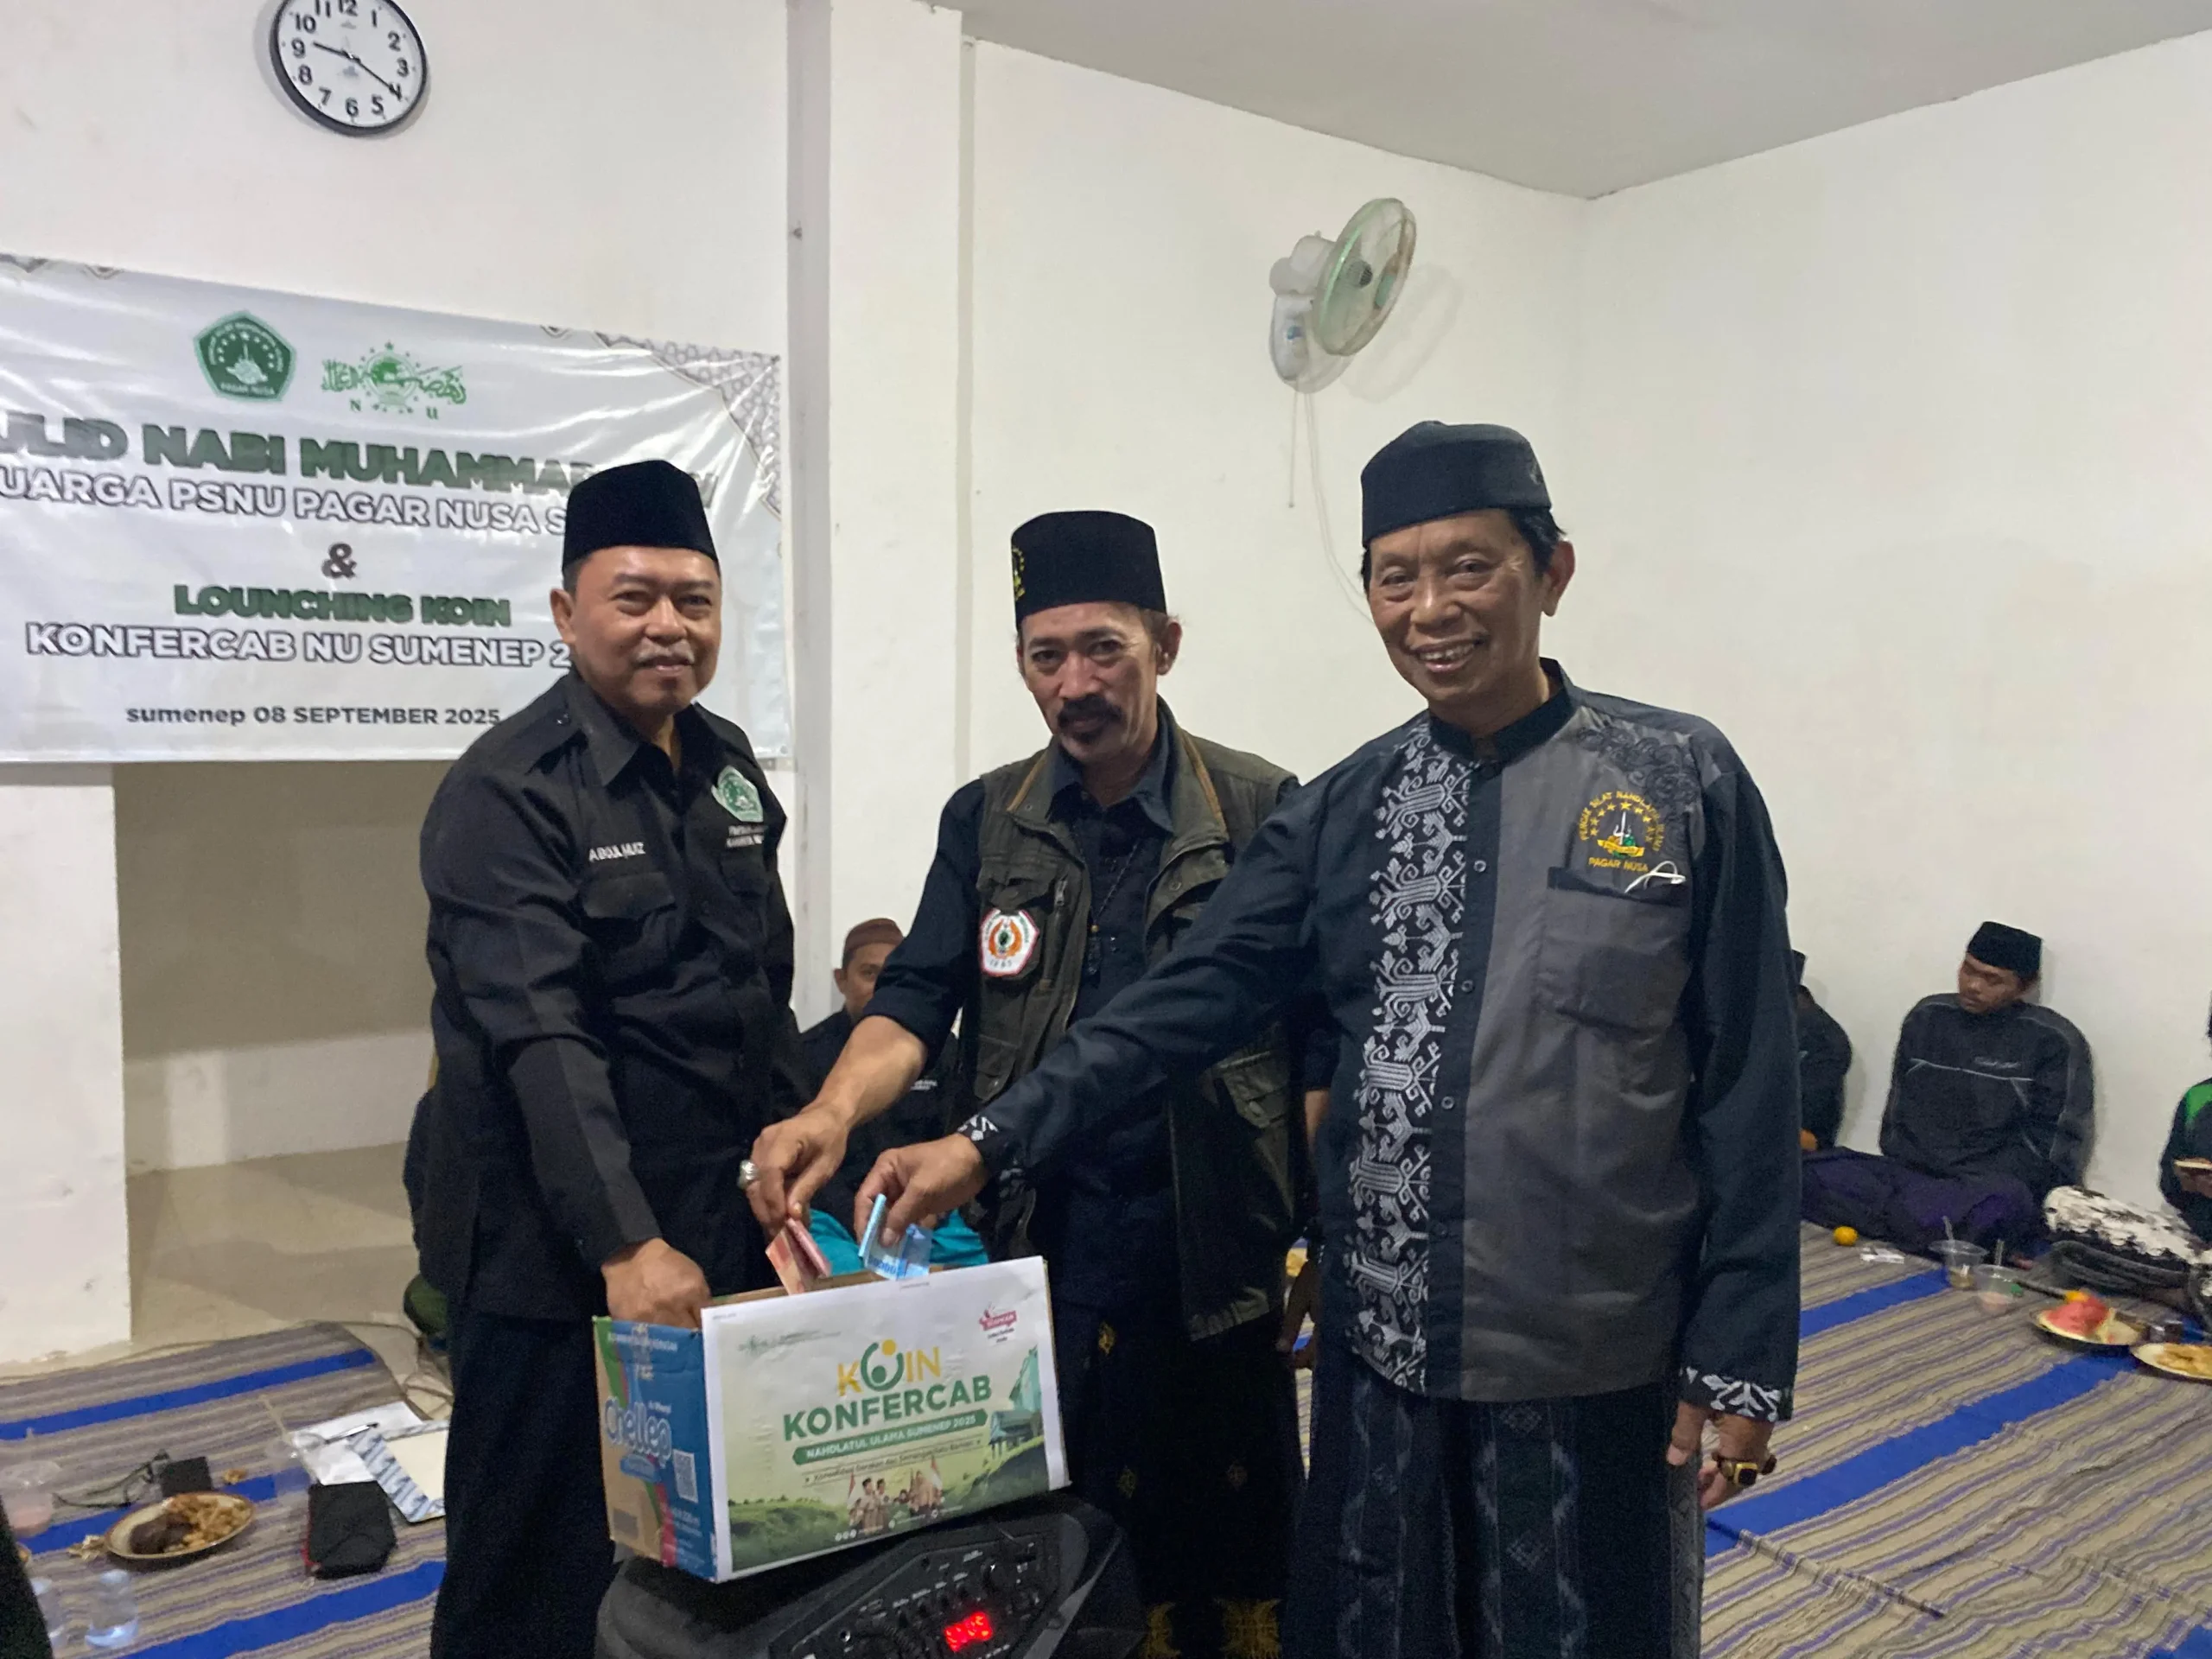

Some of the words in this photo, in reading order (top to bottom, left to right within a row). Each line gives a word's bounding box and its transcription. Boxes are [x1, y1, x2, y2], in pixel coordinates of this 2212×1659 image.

[295, 13, 316, 34] 10
[371, 9, 378, 28] 1
[291, 37, 306, 59] 9
[388, 31, 401, 52] 2
[298, 65, 313, 86] 8
[397, 57, 409, 77] 3
[319, 86, 332, 105] 7
[372, 94, 385, 115] 5
[346, 98, 359, 117] 6
[142, 423, 287, 476] NABI
[168, 477, 287, 518] PSNU
[294, 488, 430, 527] PAGAR
[436, 499, 543, 537] NUSA
[322, 542, 358, 580] &
[174, 584, 413, 625] LOUNCHING
[421, 594, 512, 627] KOIN
[26, 621, 297, 662] KONFERCAB
[302, 632, 362, 664] NU
[368, 635, 545, 668] SUMENEP
[126, 709, 246, 726] sumenep
[254, 706, 287, 723] 08
[294, 707, 438, 725] SEPTEMBER
[445, 708, 501, 726] 2025
[1588, 856, 1621, 868] PAGAR
[783, 1375, 993, 1441] KONFERCAB
